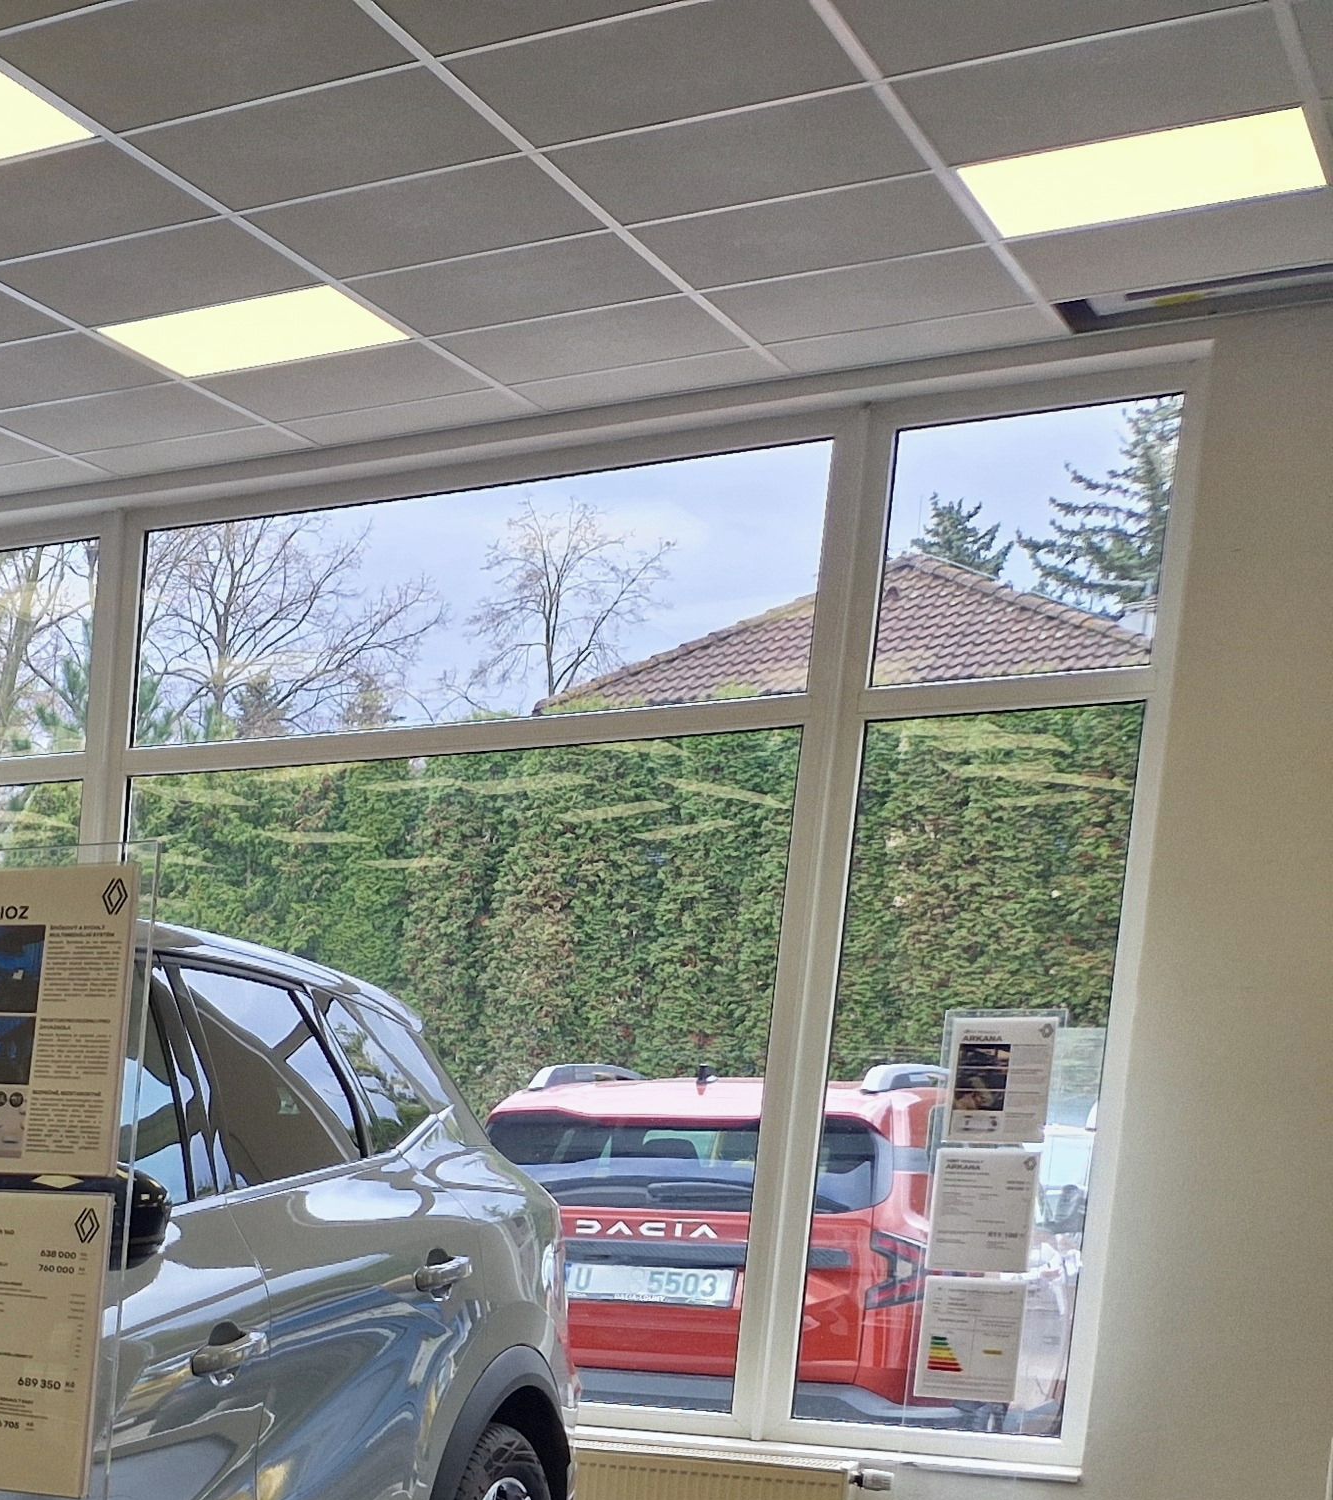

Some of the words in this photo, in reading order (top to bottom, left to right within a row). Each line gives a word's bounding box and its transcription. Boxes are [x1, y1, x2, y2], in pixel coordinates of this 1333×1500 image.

[575, 1219, 719, 1239] DACIA
[58, 1251, 77, 1260] 000
[38, 1264, 55, 1272] 760
[56, 1265, 75, 1274] 000
[647, 1271, 718, 1297] 5503
[17, 1376, 39, 1387] 689
[40, 1379, 61, 1390] 350
